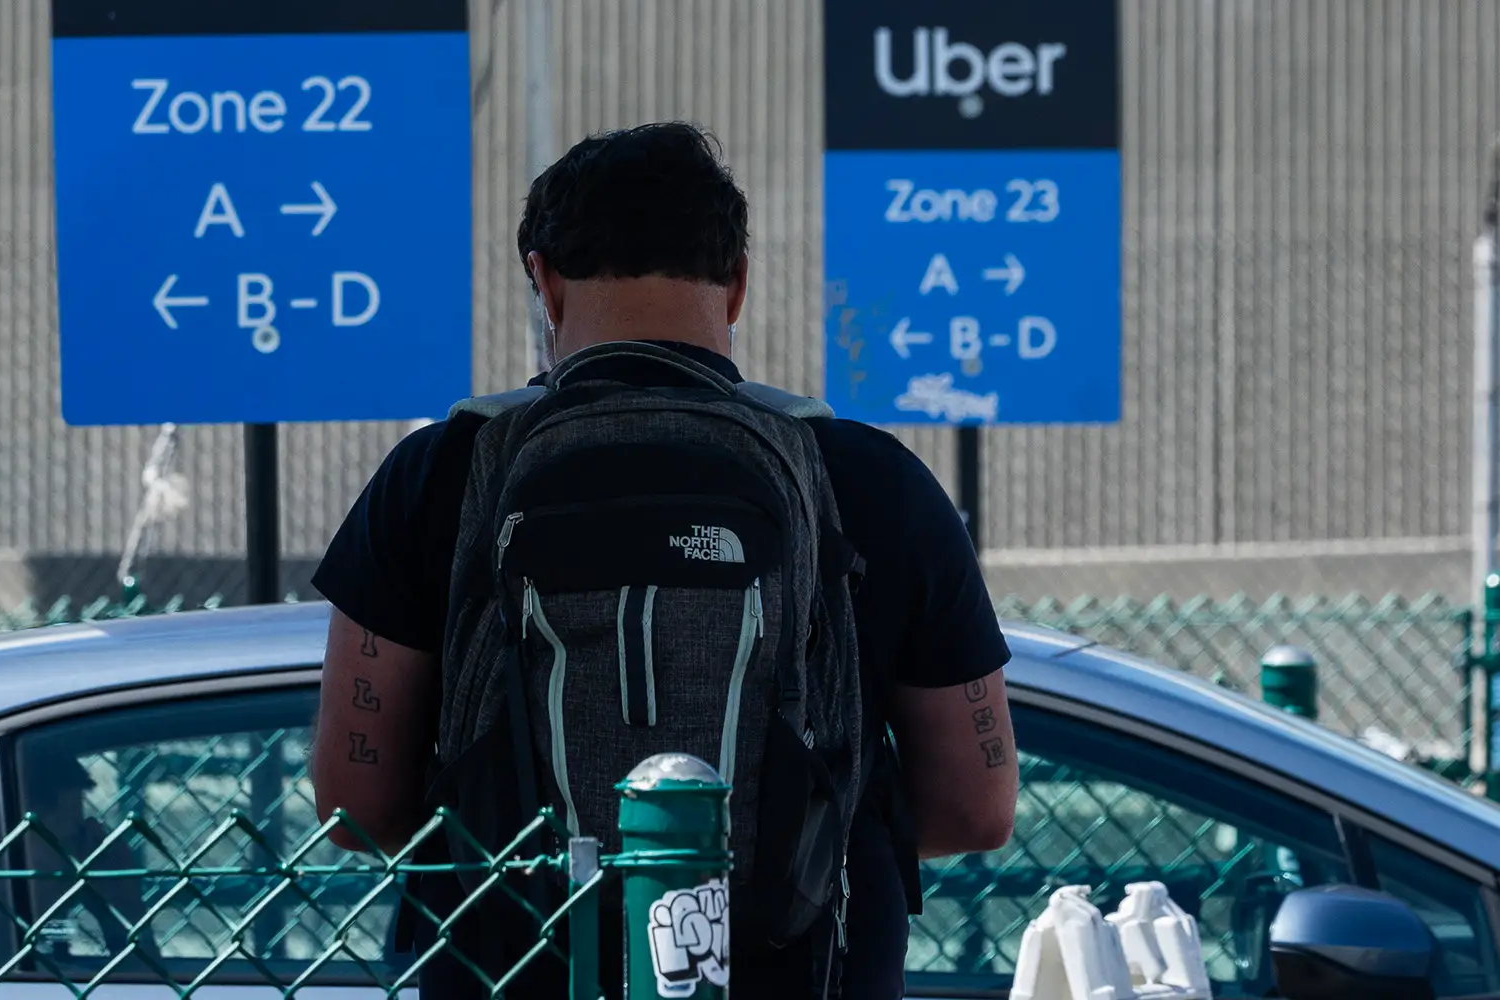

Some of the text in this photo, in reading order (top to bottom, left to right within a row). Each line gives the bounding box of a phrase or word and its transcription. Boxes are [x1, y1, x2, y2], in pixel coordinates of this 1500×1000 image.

[875, 27, 1066, 96] Uber
[132, 76, 372, 134] Zone 22
[195, 183, 244, 237] A
[884, 179, 1060, 223] Zone 23
[919, 254, 959, 294] A
[238, 273, 277, 328] B
[332, 271, 380, 326] D
[950, 316, 982, 360] B
[1018, 315, 1057, 360] D
[669, 536, 719, 550] NORTH
[691, 525, 720, 539] THE
[684, 548, 720, 561] FACE
